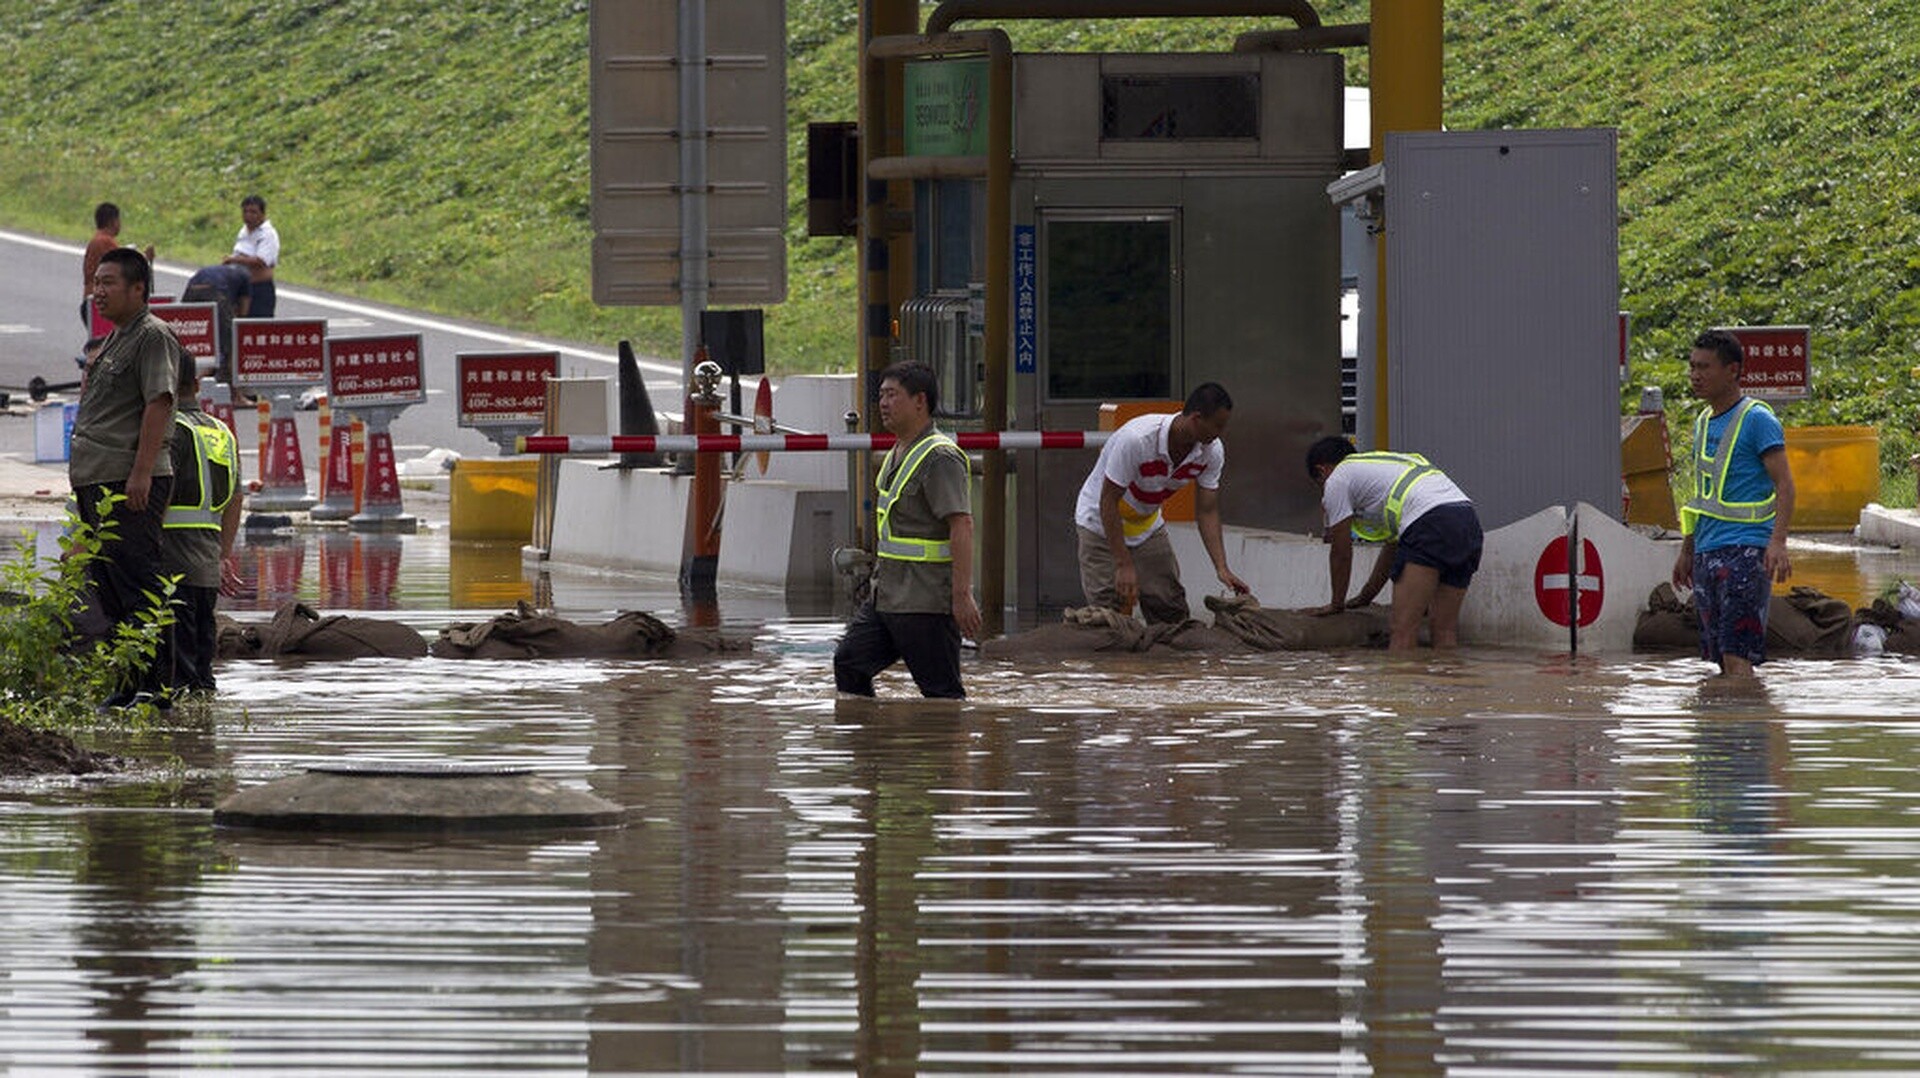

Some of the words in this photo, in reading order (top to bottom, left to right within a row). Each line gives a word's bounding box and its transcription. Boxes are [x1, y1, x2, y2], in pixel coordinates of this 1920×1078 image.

[1018, 232, 1034, 366] 非工作人员禁止入内
[243, 333, 320, 346] 共建和谐社会
[1742, 344, 1803, 357] 和谐社会
[243, 357, 320, 370] 400-883-6878
[335, 350, 416, 367] 共建和谐社会
[1741, 371, 1803, 383] -883-6878
[337, 376, 417, 392] 400-883-6878
[466, 396, 545, 409] 400-883-687
